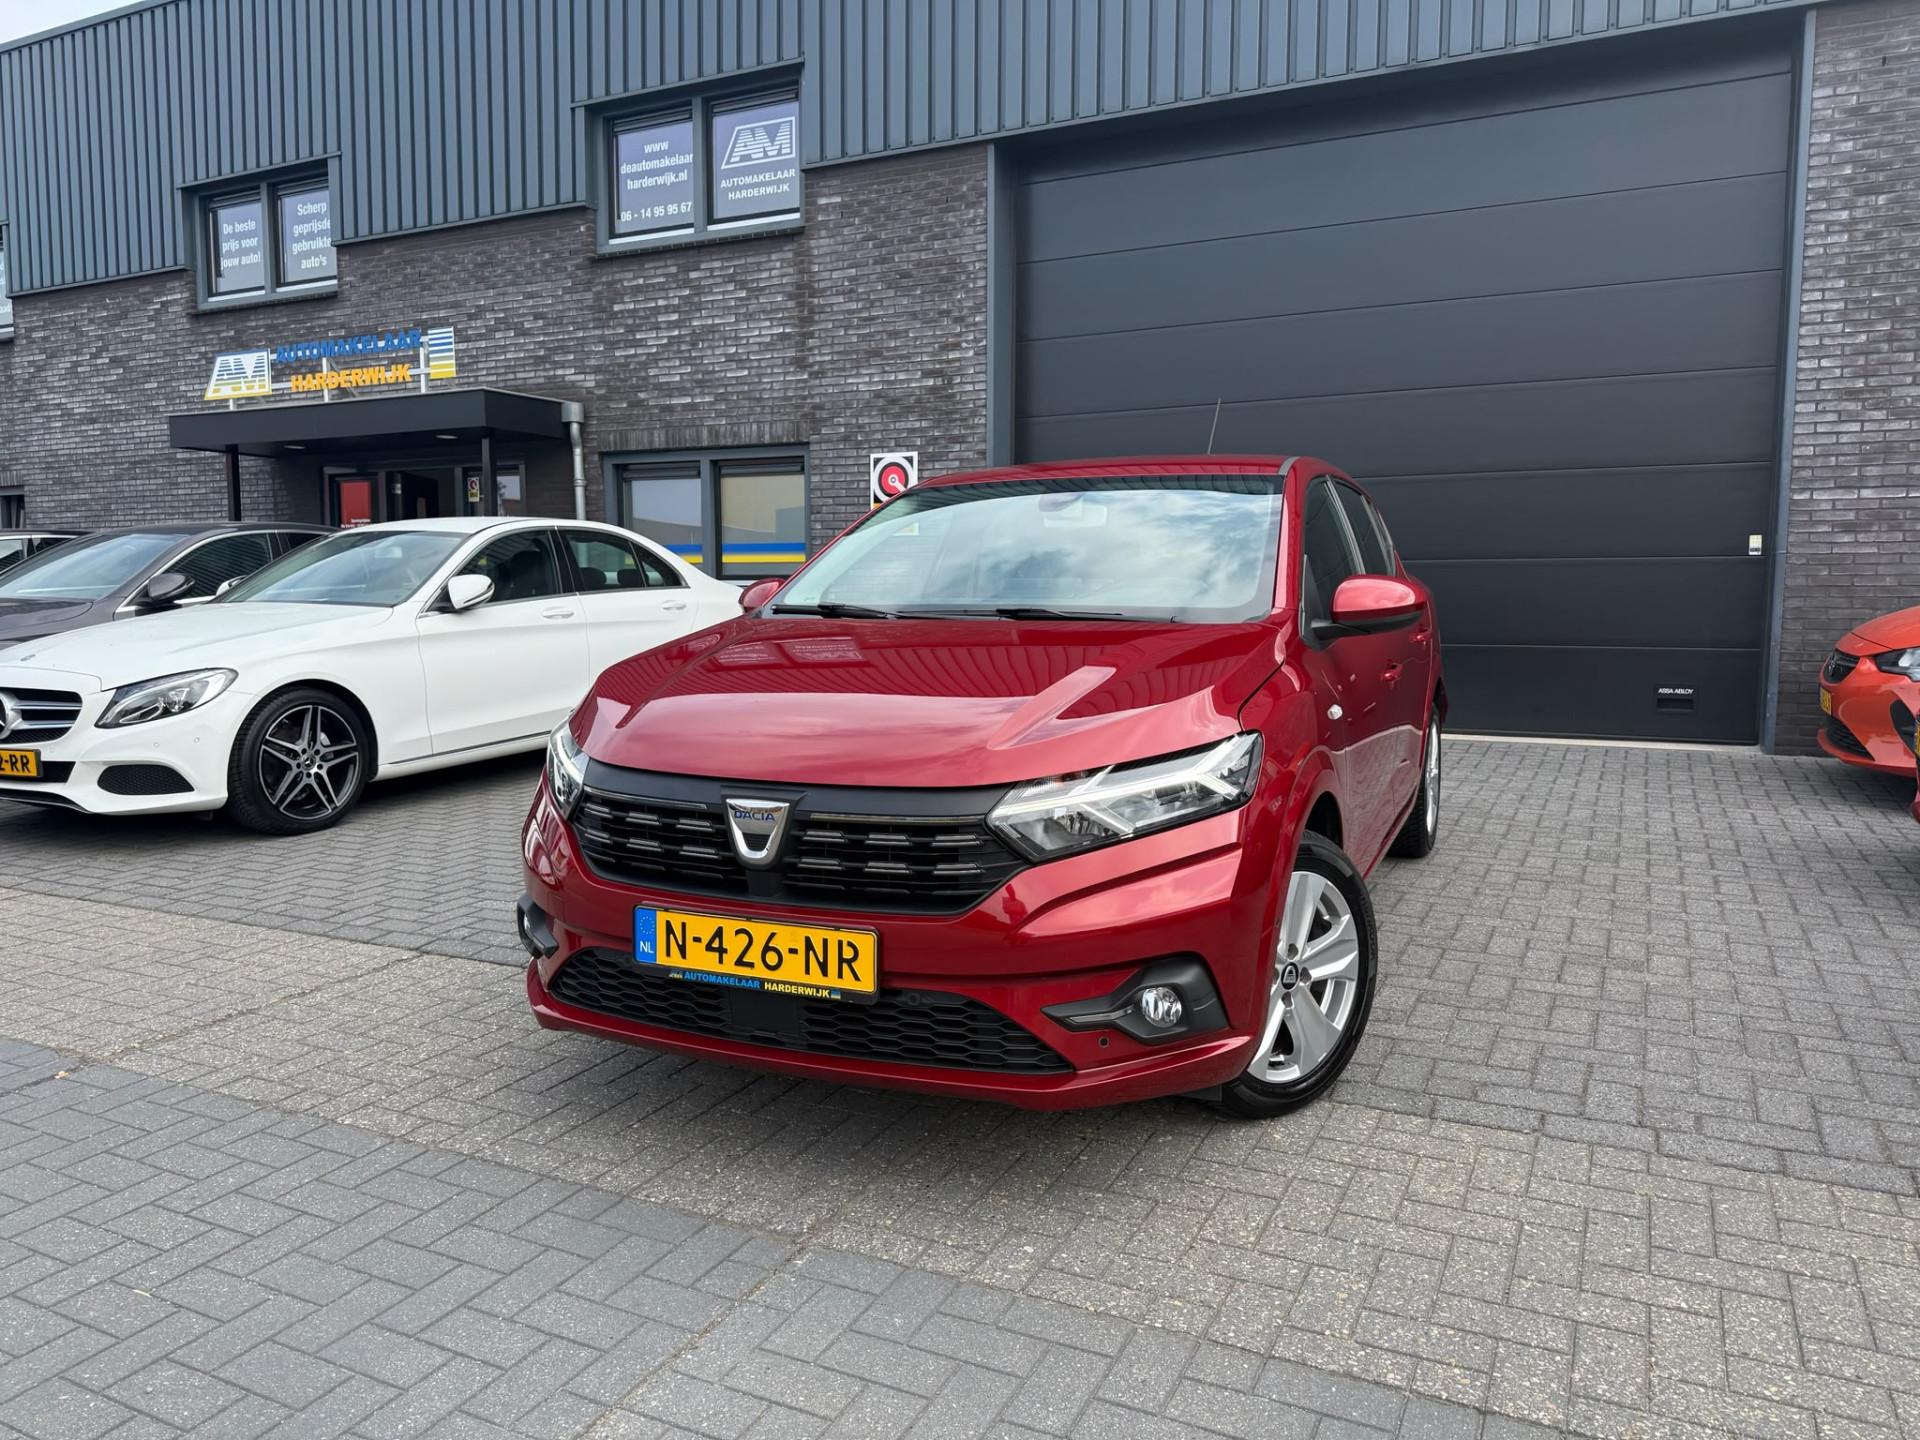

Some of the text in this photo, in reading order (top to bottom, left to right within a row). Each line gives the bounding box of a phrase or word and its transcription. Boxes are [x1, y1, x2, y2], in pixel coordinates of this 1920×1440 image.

[644, 140, 669, 154] www
[620, 153, 693, 174] deautomakelaar
[627, 169, 688, 191] harderwijk.nl
[720, 168, 796, 189] AUTOMAKELAAR
[728, 183, 790, 201] HARDERWIJK
[297, 201, 327, 216] Scherp
[620, 210, 632, 222] 06
[641, 208, 651, 219] 14
[653, 206, 664, 217] 95
[667, 204, 679, 215] 95
[680, 201, 692, 213] 67
[223, 219, 256, 235] De beste
[293, 217, 331, 237] geprijsde
[222, 236, 259, 254] prijs voor
[292, 236, 332, 256] gebruikte
[220, 256, 240, 271] jouw
[301, 254, 328, 270] auto's
[275, 328, 422, 363] AUTOMAKELAAR
[290, 363, 413, 392] HARDERWIJK
[733, 809, 776, 822] DACIA
[639, 940, 655, 955] NL
[664, 919, 862, 983] N-426-NR
[684, 971, 761, 990] AUTOMAKELAAR
[763, 981, 831, 999] HARDERWIJK
